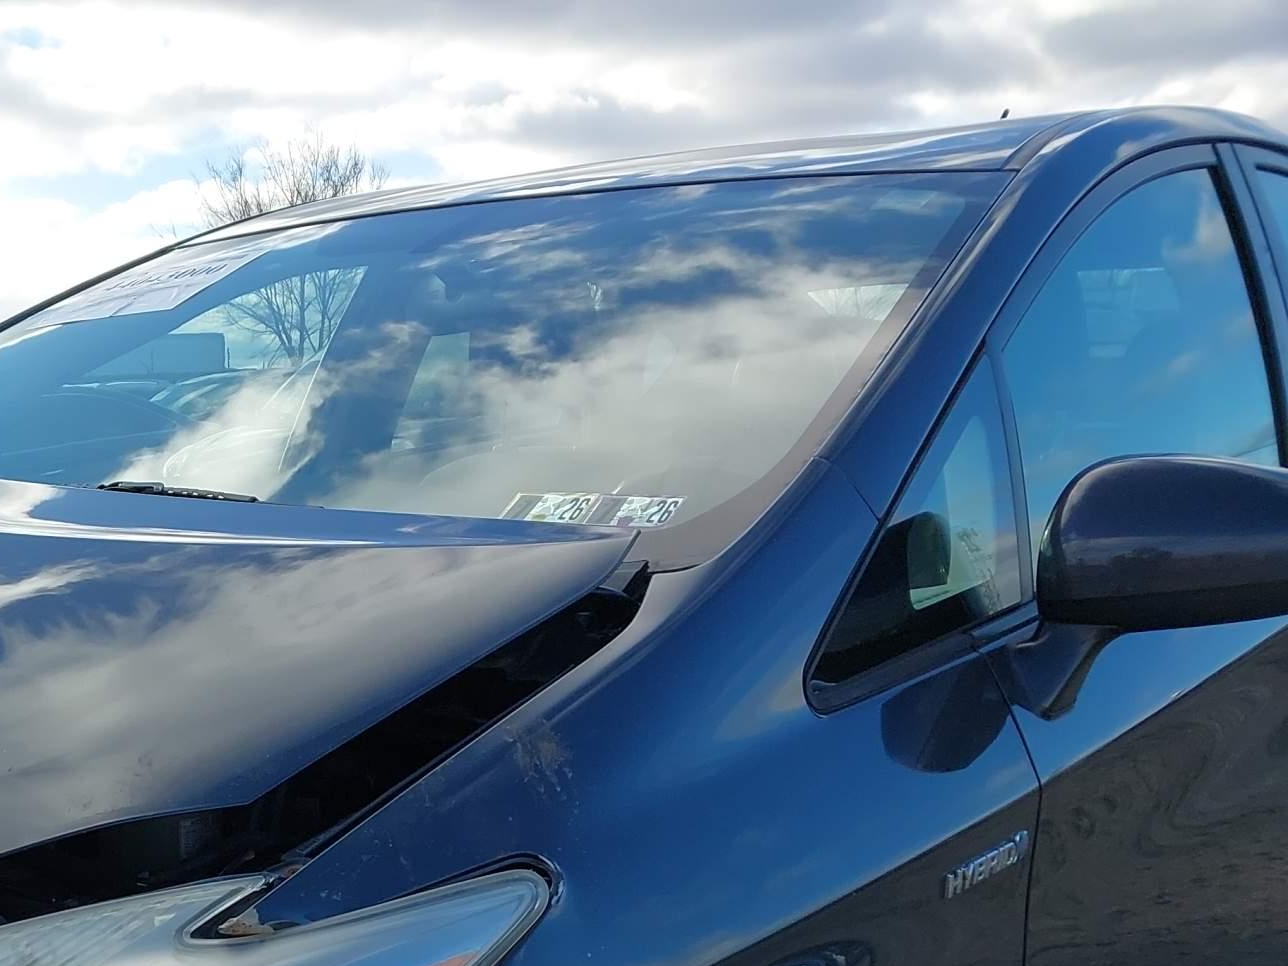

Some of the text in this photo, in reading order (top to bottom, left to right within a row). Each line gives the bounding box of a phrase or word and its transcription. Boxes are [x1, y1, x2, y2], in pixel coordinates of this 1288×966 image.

[558, 497, 592, 521] 26
[646, 499, 680, 524] 26
[944, 841, 1019, 899] HYBRID
